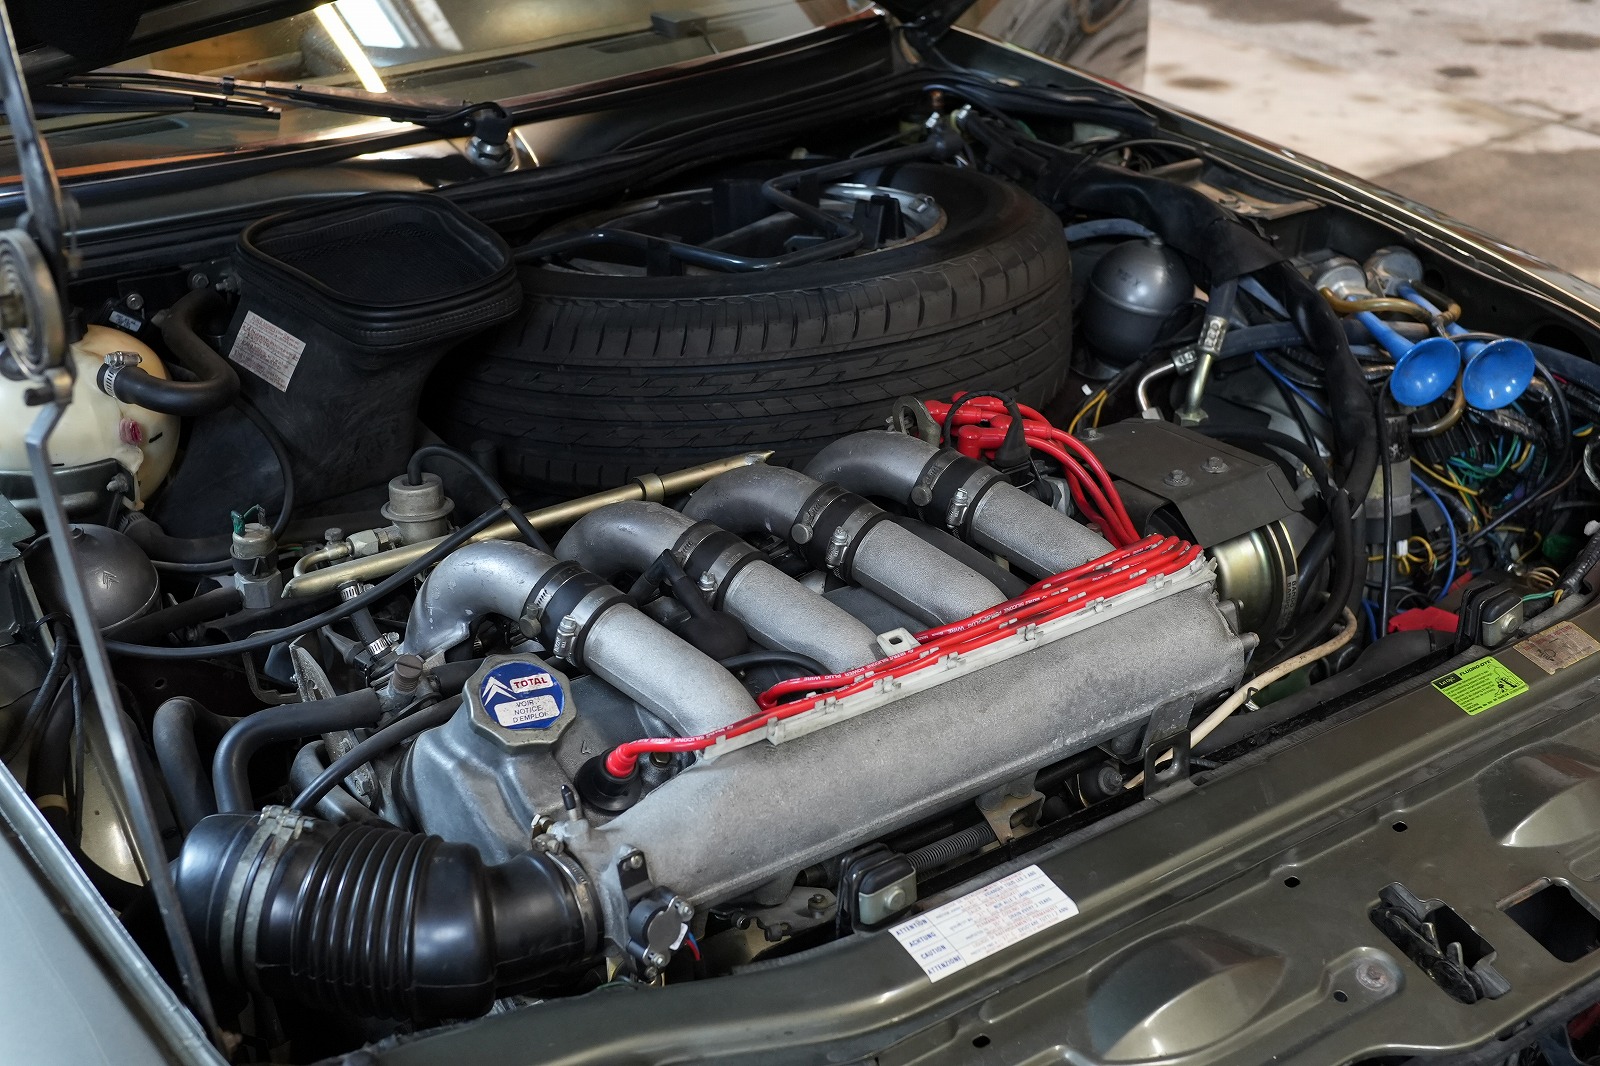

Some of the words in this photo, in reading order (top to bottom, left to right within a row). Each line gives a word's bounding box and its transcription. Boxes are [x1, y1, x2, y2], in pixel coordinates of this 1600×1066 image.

[513, 677, 548, 689] TOTAL
[514, 705, 543, 715] NOTICE
[516, 699, 534, 708] VOIR
[674, 735, 705, 743] SILICONE
[895, 918, 928, 936] ATTENTION
[908, 931, 937, 947] ACHTUNG
[920, 944, 947, 960] CAUTION
[926, 955, 962, 975] ATTENZIONE
